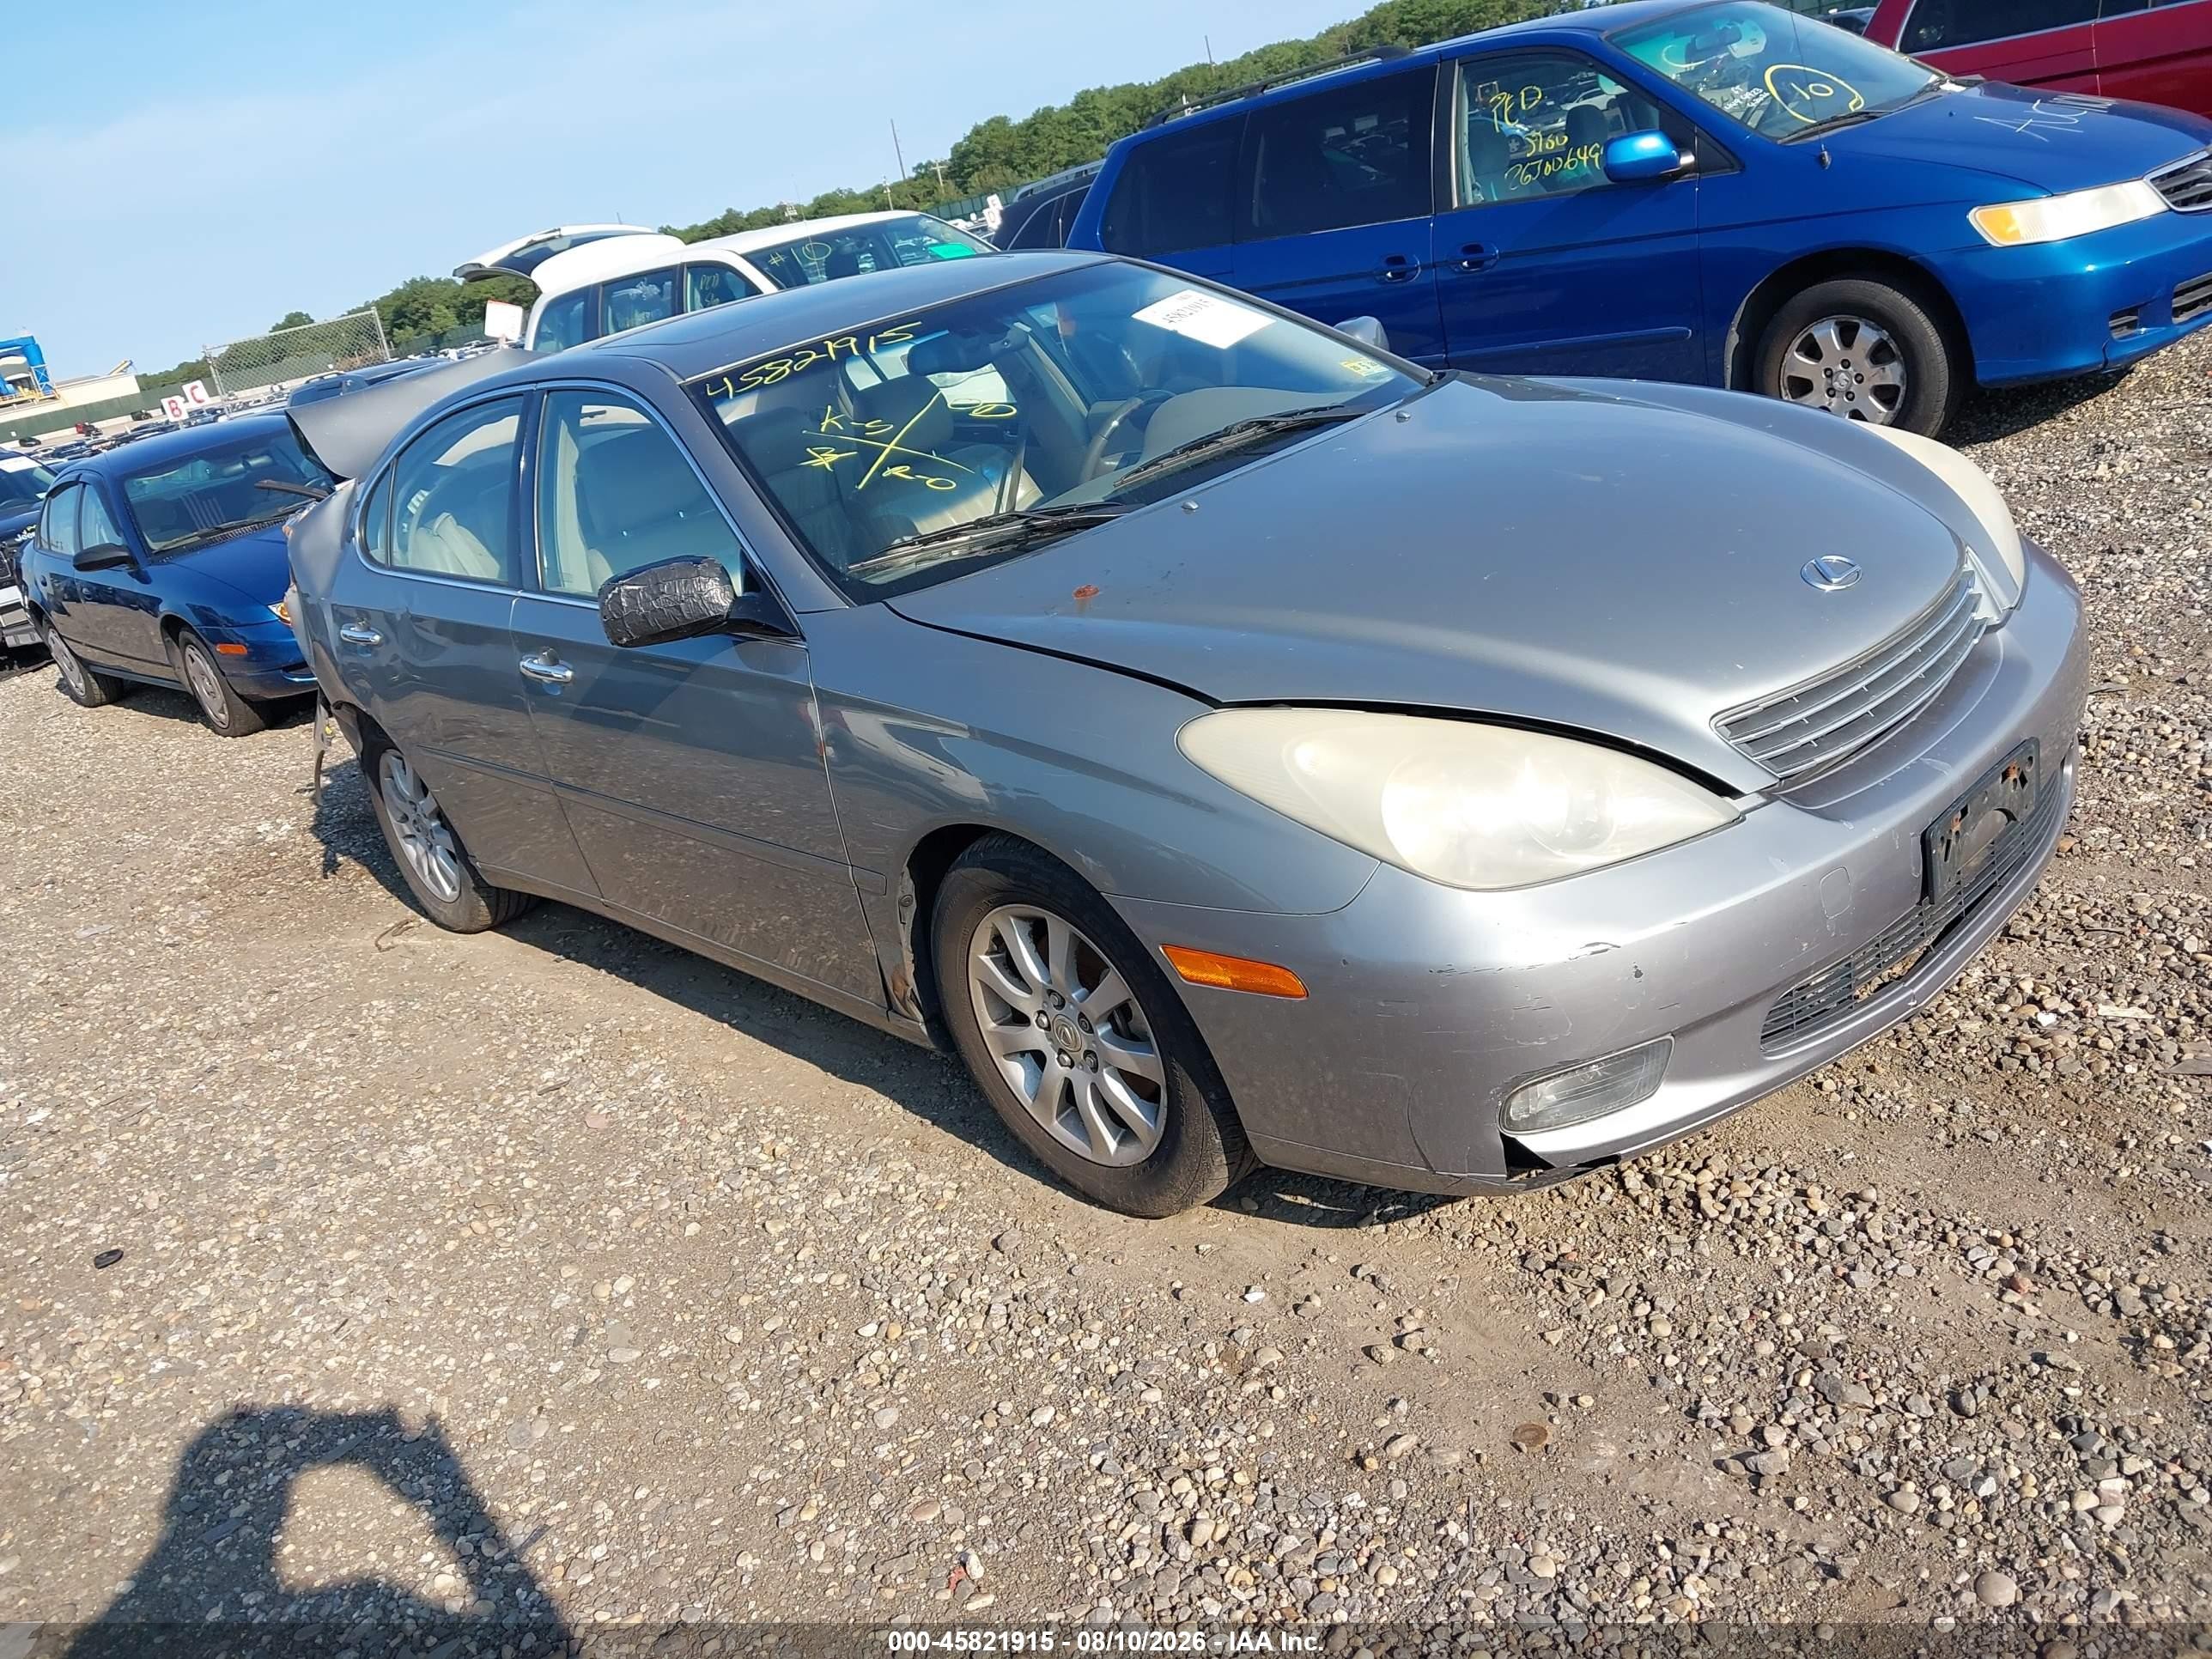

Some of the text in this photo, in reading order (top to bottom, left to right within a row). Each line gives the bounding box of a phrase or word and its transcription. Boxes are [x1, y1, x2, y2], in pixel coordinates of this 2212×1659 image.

[1790, 82, 1834, 100] 10
[705, 320, 922, 400] 45821915
[190, 385, 205, 404] C
[168, 399, 182, 418] B
